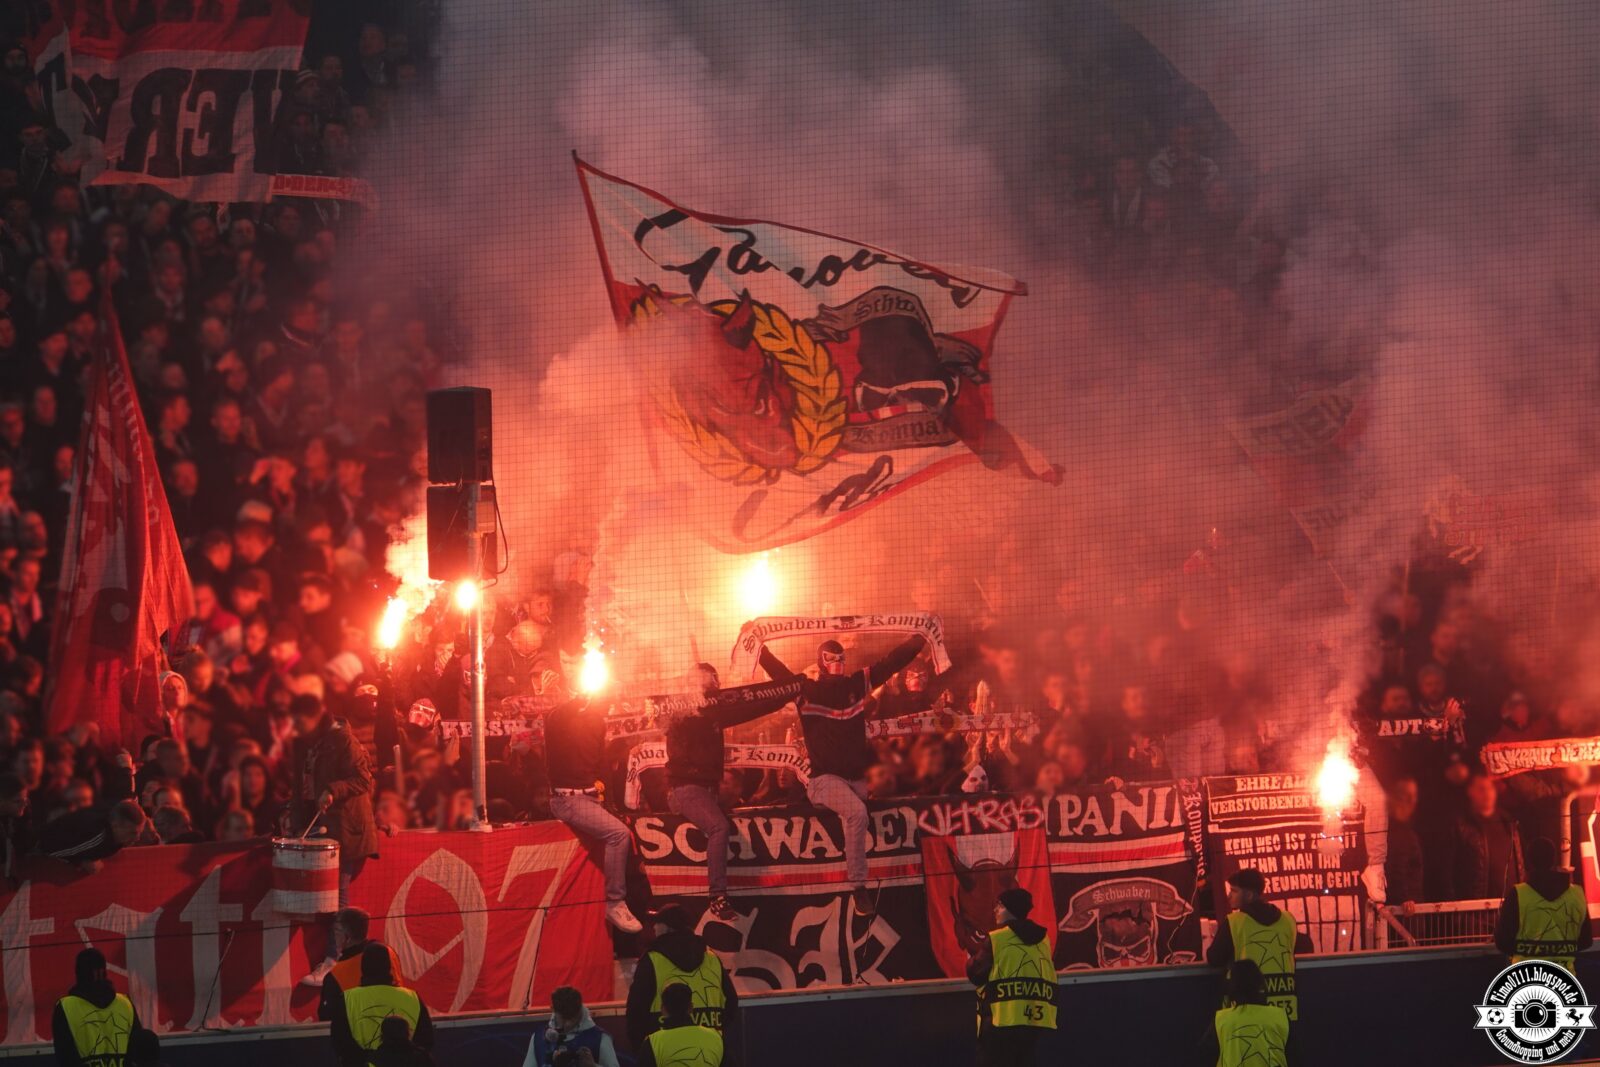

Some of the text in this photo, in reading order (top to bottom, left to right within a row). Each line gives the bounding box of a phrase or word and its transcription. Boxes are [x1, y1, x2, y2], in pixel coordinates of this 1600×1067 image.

[851, 417, 942, 445] Kompa
[743, 618, 827, 653] Schwaben
[1377, 718, 1423, 737] ADT
[746, 747, 810, 774] Kompa
[1235, 775, 1282, 792] EHRE
[918, 797, 1045, 836] ULTRAS
[1211, 795, 1311, 815] VERSTORBENEN
[634, 805, 923, 863] SCHWAEN
[1224, 836, 1254, 856] KEIN
[1285, 832, 1307, 850] IST
[1282, 852, 1313, 872] MAN
[1318, 853, 1341, 870] IHN
[1263, 870, 1361, 894] REUNDEN GEHT
[1092, 885, 1152, 904] Schwaben
[384, 837, 582, 1015] 97
[1023, 1004, 1044, 1022] 43
